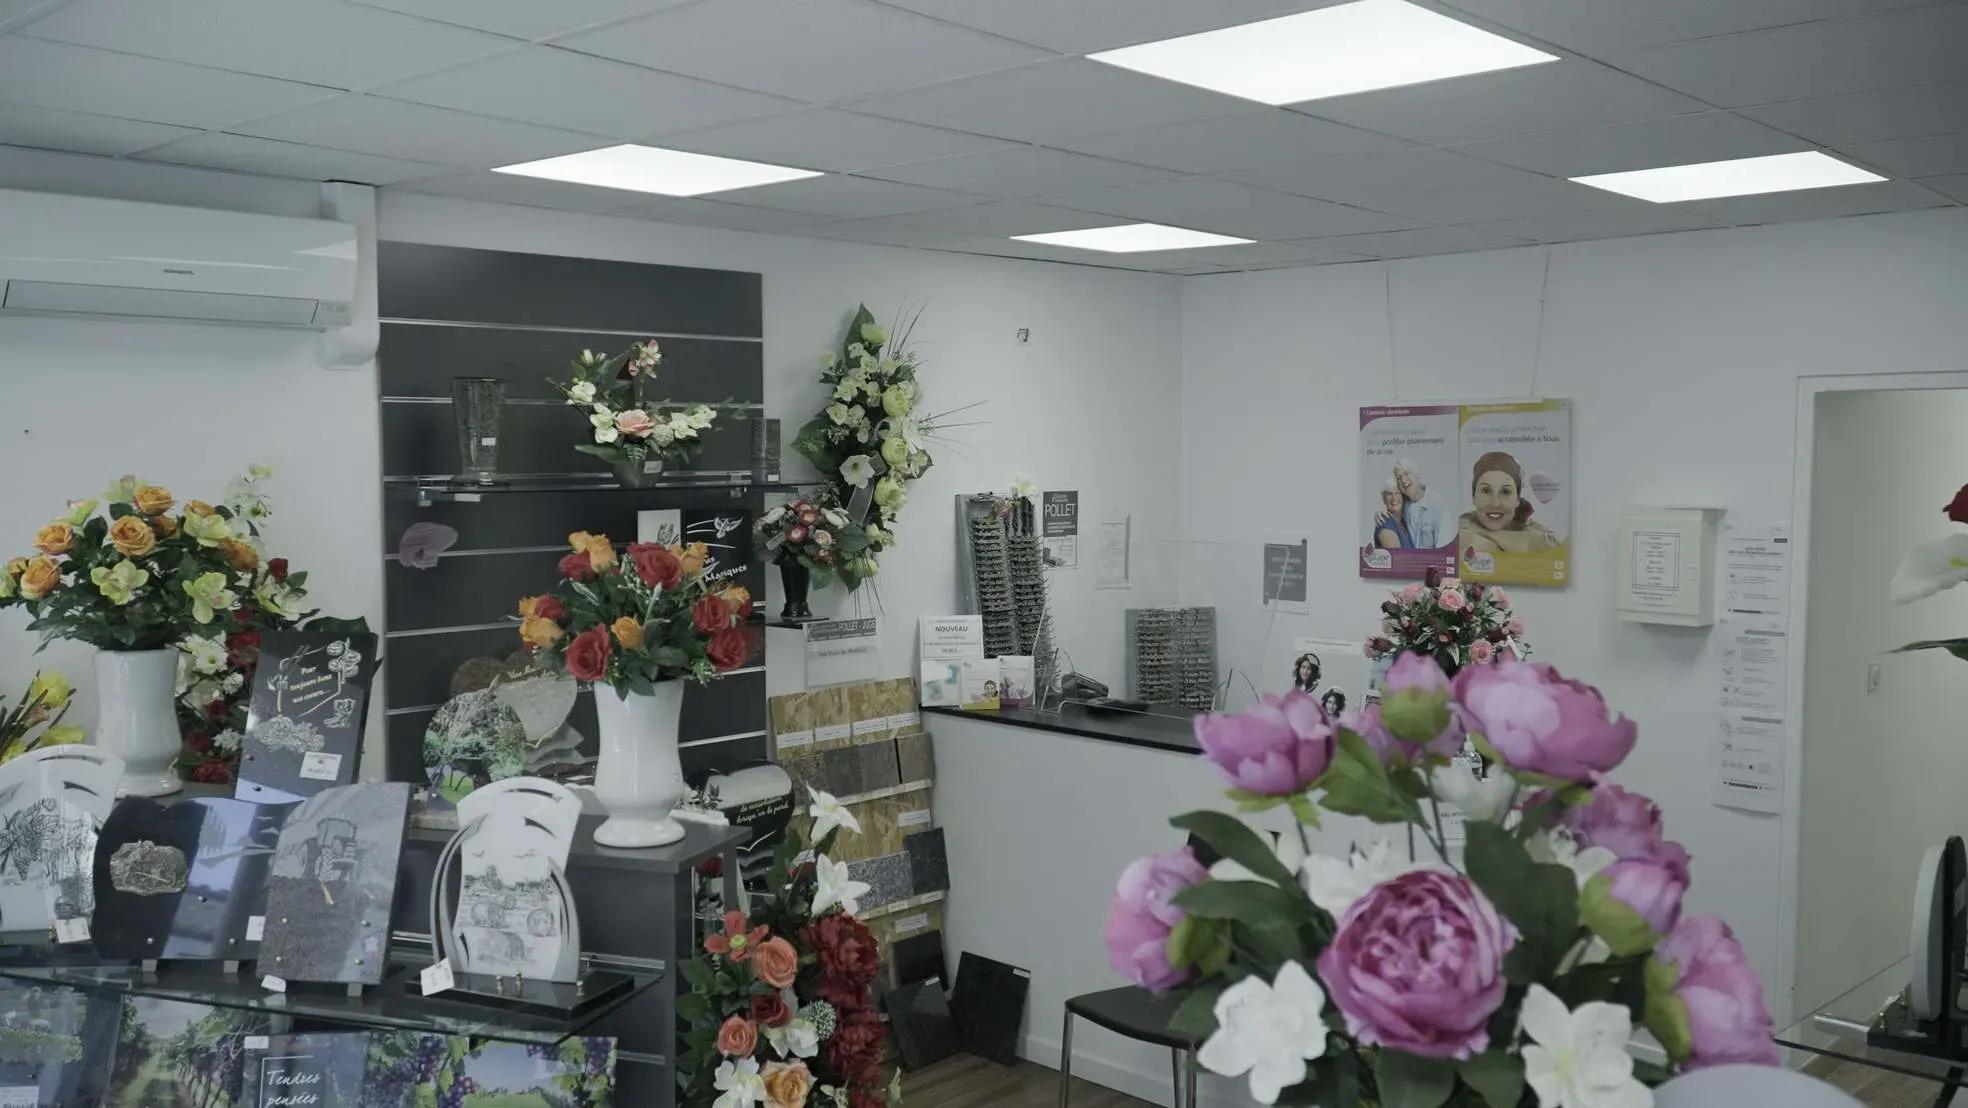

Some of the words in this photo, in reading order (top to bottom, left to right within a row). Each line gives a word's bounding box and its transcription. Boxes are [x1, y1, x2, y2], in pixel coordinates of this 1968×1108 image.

[1045, 503, 1076, 517] POLLET
[704, 564, 748, 582] Manques
[267, 1069, 321, 1085] Tendres
[265, 1091, 319, 1108] pensées
